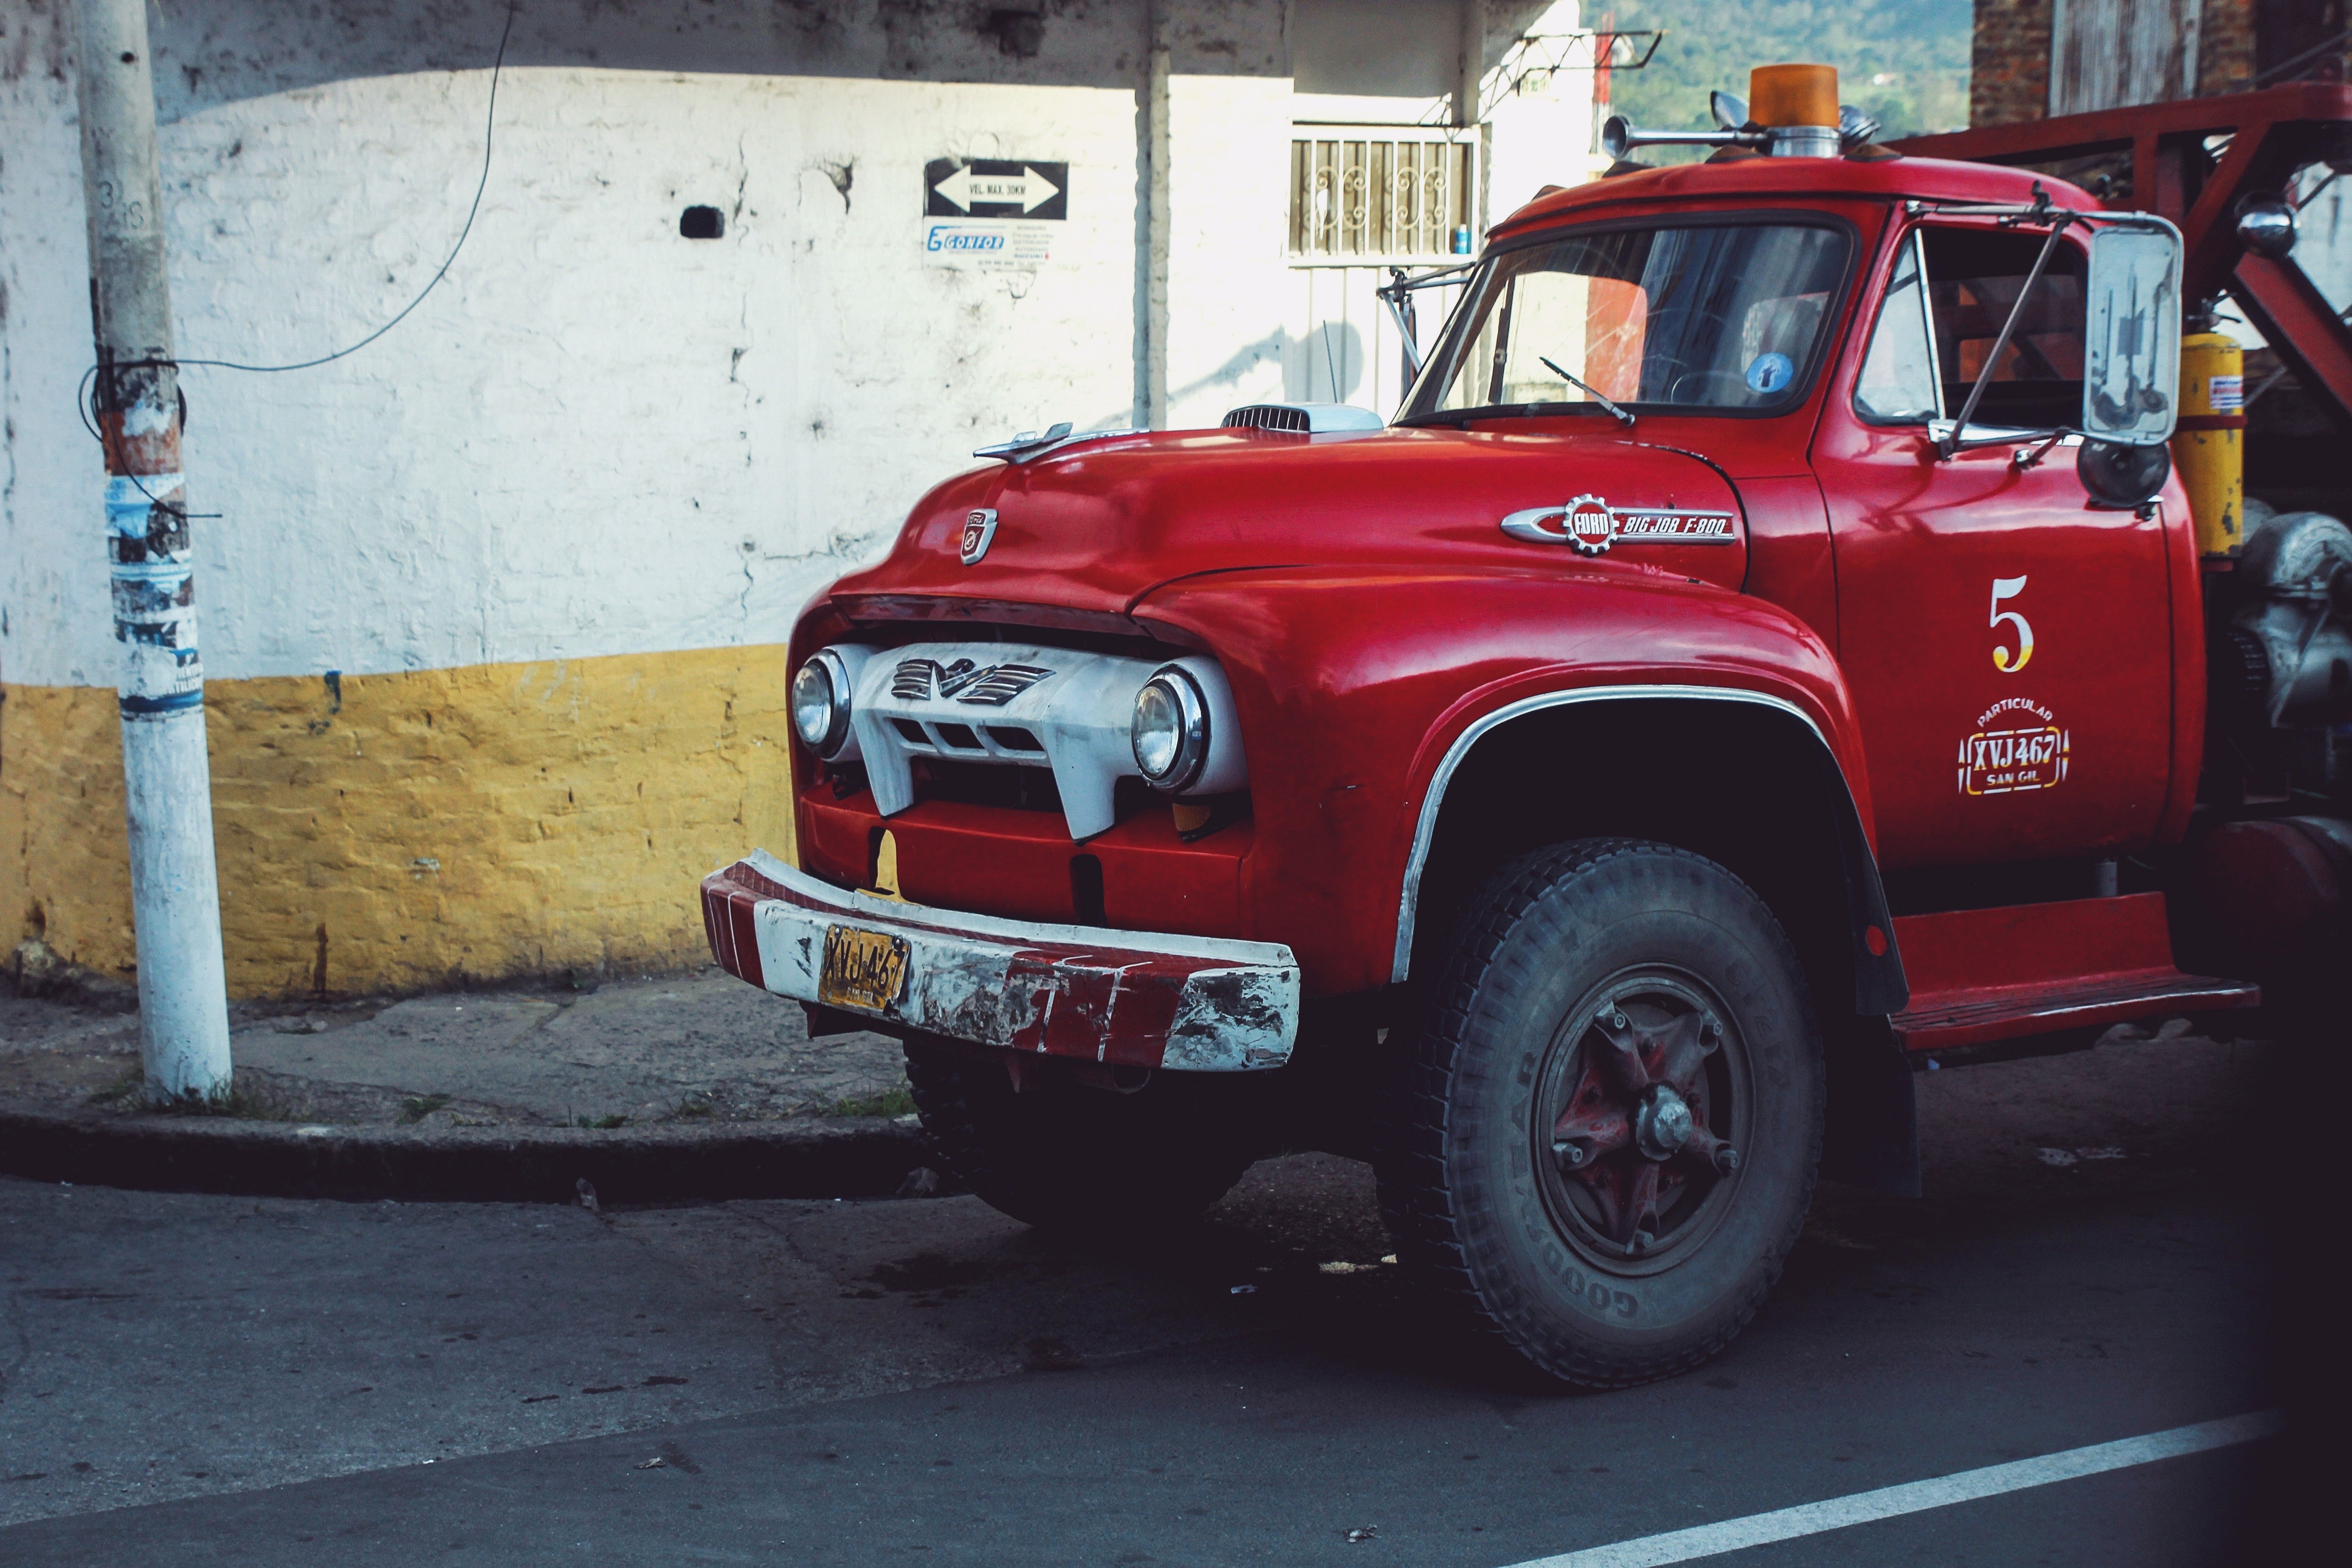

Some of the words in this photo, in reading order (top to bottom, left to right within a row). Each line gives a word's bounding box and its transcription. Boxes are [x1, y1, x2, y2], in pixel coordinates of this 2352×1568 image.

[1574, 512, 1609, 535] FORD
[1624, 516, 1650, 533] BIG
[1649, 518, 1679, 533] JOB
[1990, 575, 2034, 673] 5
[1977, 697, 2053, 728] PARTICULAR
[1973, 735, 2056, 771] XVJ467
[1986, 773, 2014, 786] SAN
[2017, 770, 2040, 782] GIL
